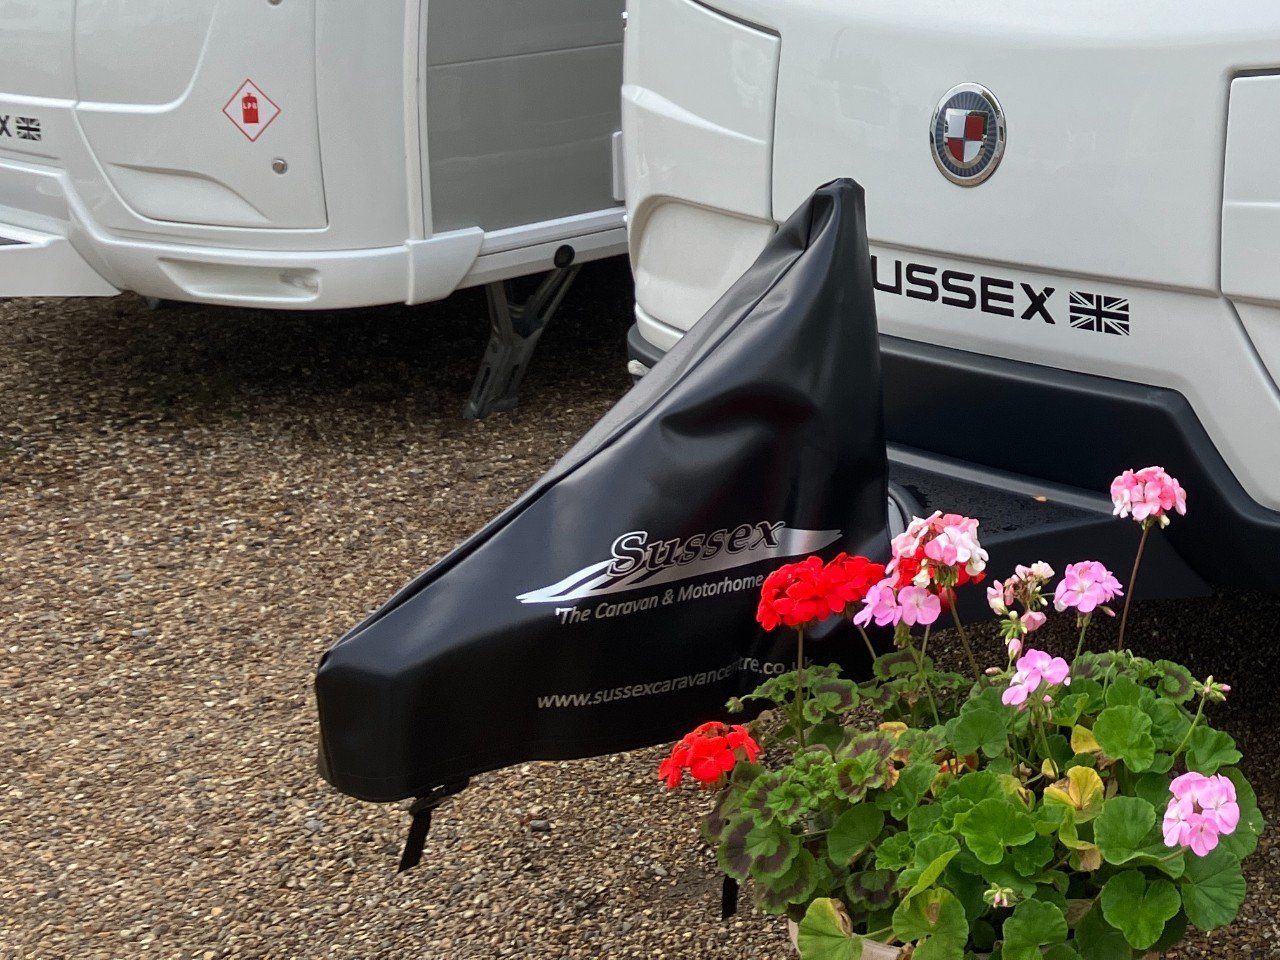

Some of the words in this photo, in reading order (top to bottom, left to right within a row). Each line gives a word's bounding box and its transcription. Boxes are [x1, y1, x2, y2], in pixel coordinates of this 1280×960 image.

[871, 254, 1055, 325] USSEX
[607, 521, 786, 577] Sussex
[595, 594, 659, 619] Caravan
[662, 589, 674, 605] &
[677, 575, 764, 602] Motorhome
